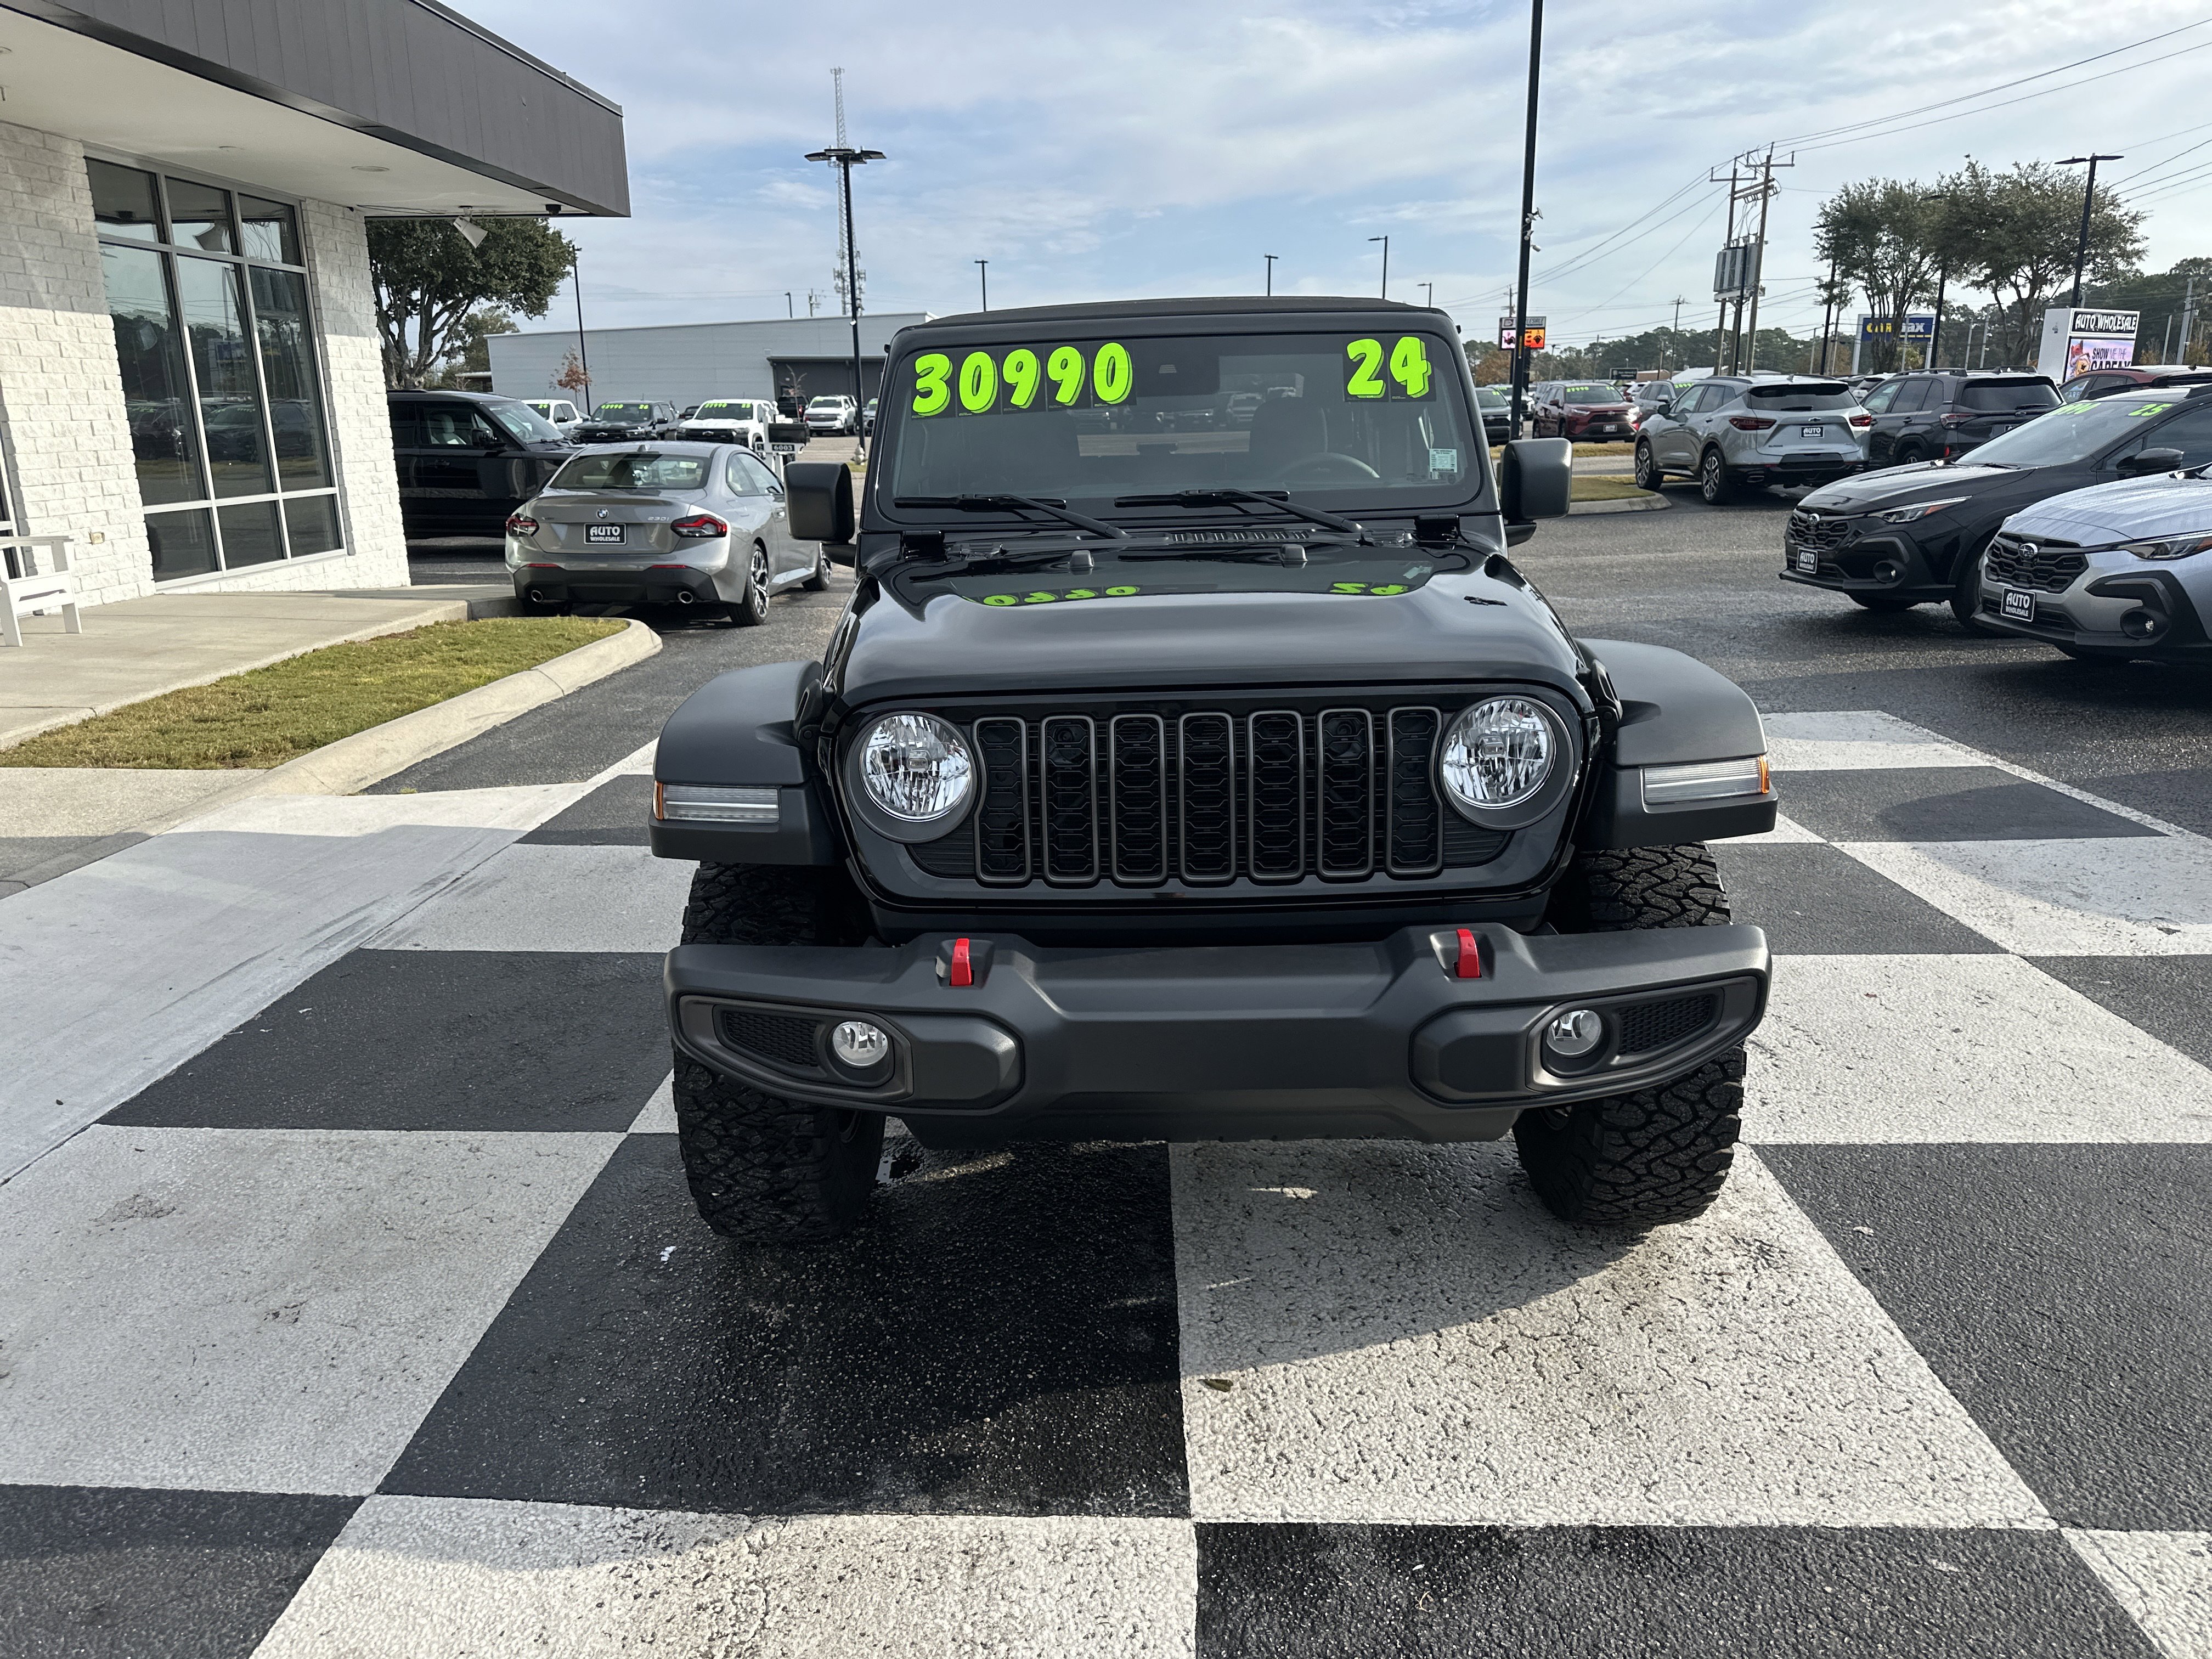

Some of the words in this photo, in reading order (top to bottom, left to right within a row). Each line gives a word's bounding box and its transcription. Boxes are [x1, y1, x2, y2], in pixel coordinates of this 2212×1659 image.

[2075, 314, 2097, 329] AUTO
[2097, 315, 2137, 331] WHOLESALE
[2092, 347, 2109, 359] SHOW
[1346, 336, 1431, 398] 24
[912, 341, 1134, 417] 30990
[2127, 403, 2173, 417] 25
[590, 526, 620, 536] AUTO
[1799, 551, 1815, 563] AUTO
[2006, 592, 2030, 608] AUTO
[2005, 606, 2029, 617] WHOLESALE
